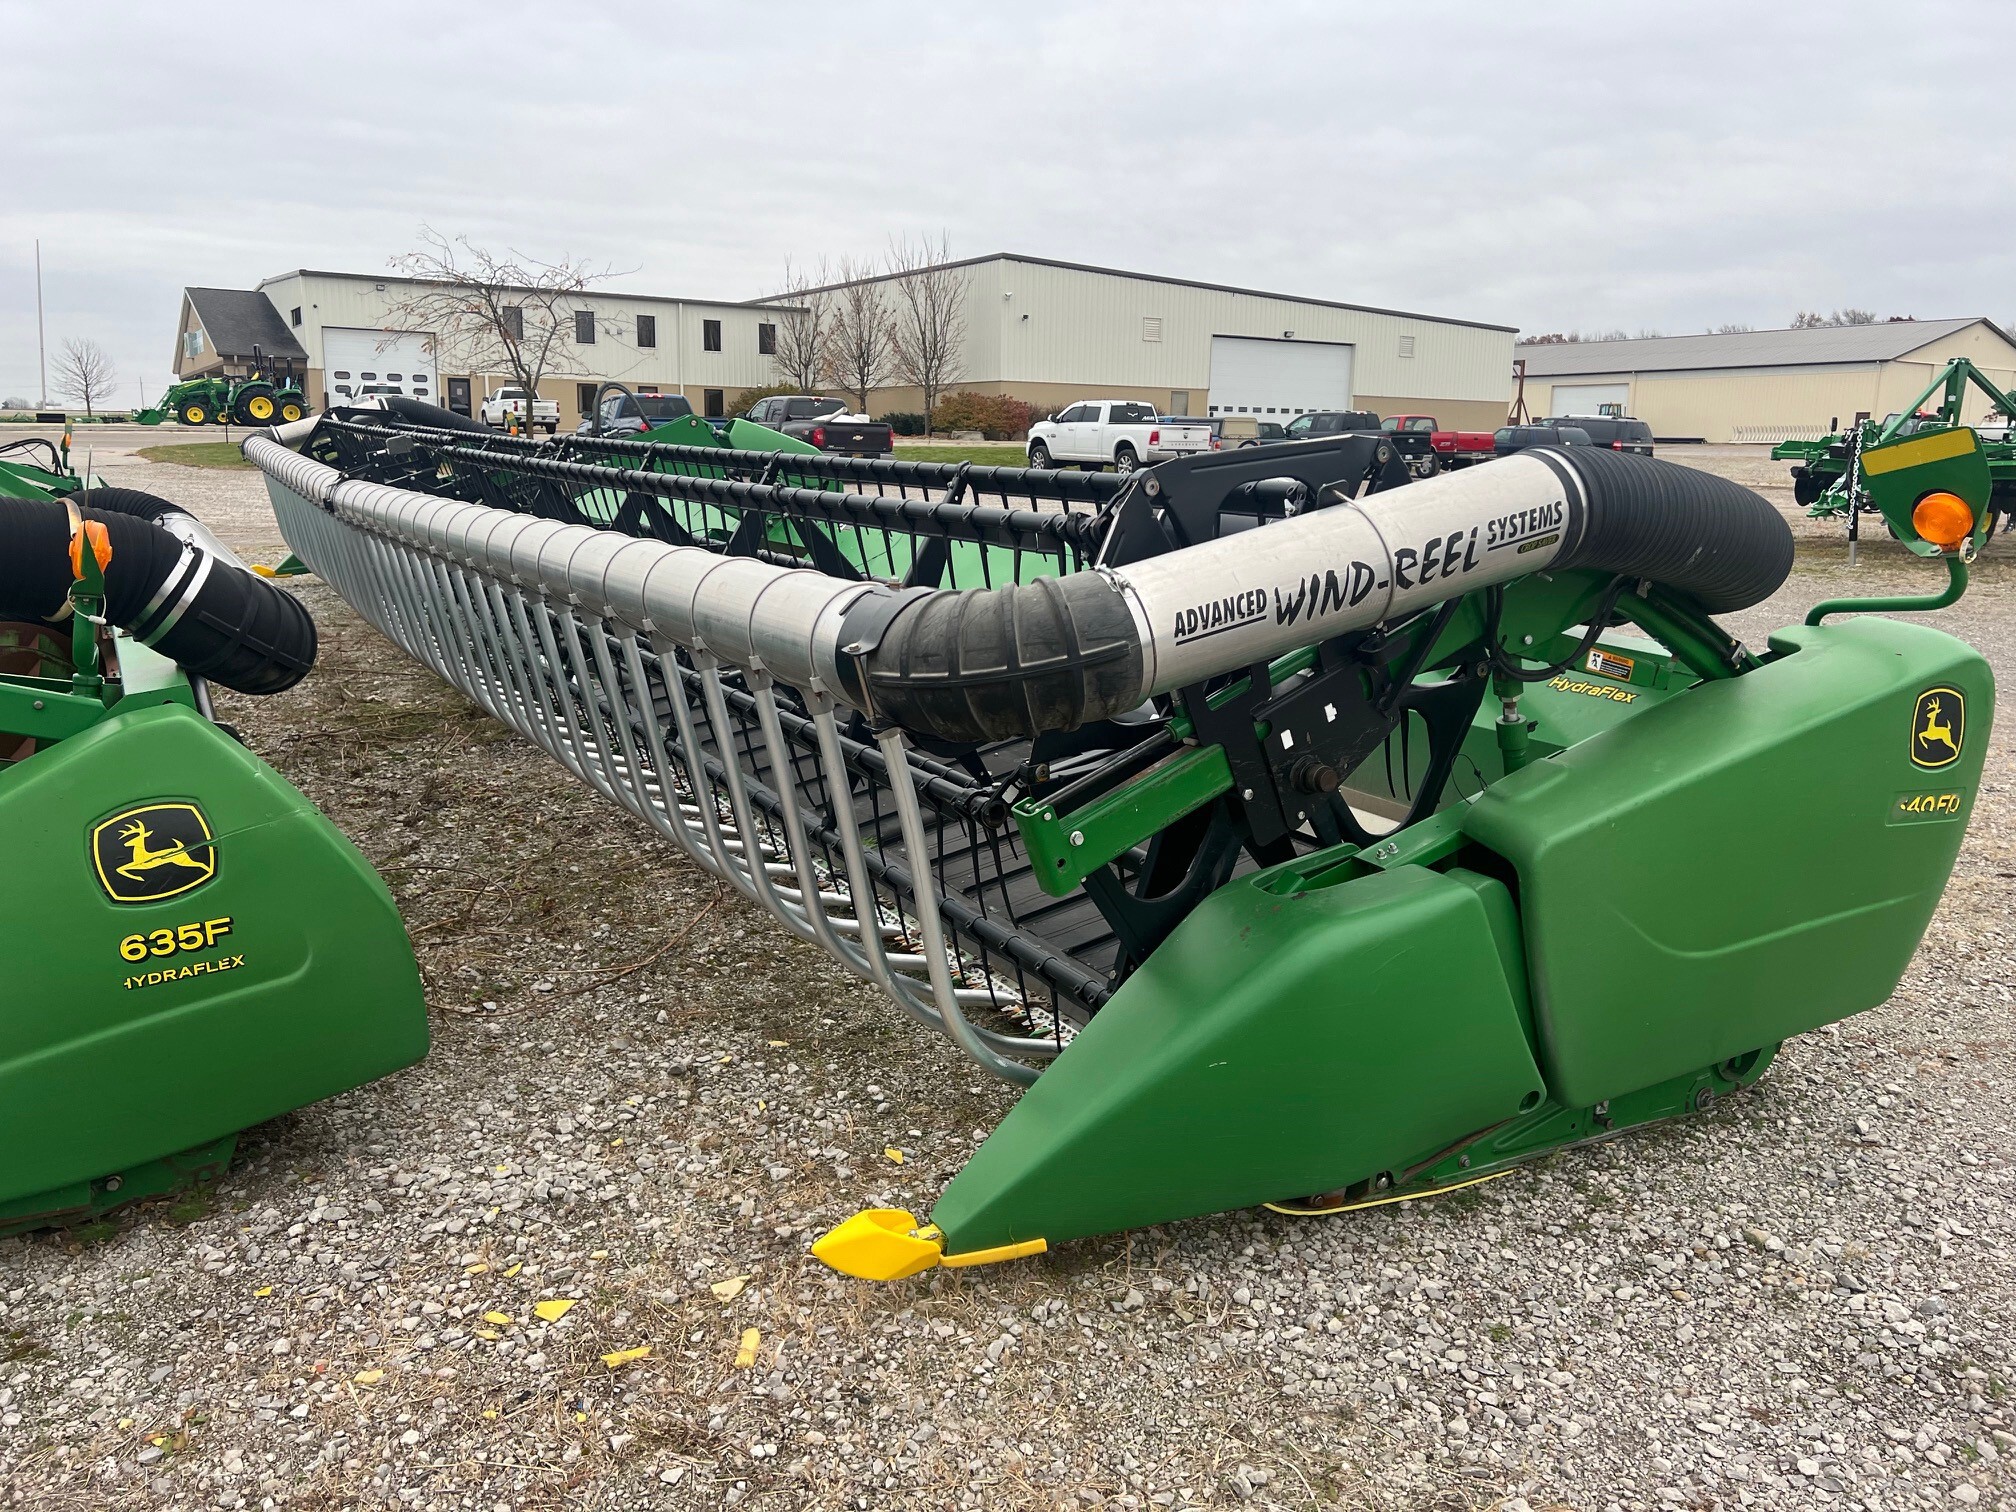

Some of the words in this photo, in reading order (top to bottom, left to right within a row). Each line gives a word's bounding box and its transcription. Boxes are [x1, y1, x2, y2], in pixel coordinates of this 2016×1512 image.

[1174, 588, 1267, 638] ADVANCED
[1274, 526, 1480, 627] WIND-REEL
[1487, 501, 1563, 545] SYSTEMS
[1548, 676, 1638, 703] HydraFlex
[120, 917, 232, 962] 635F
